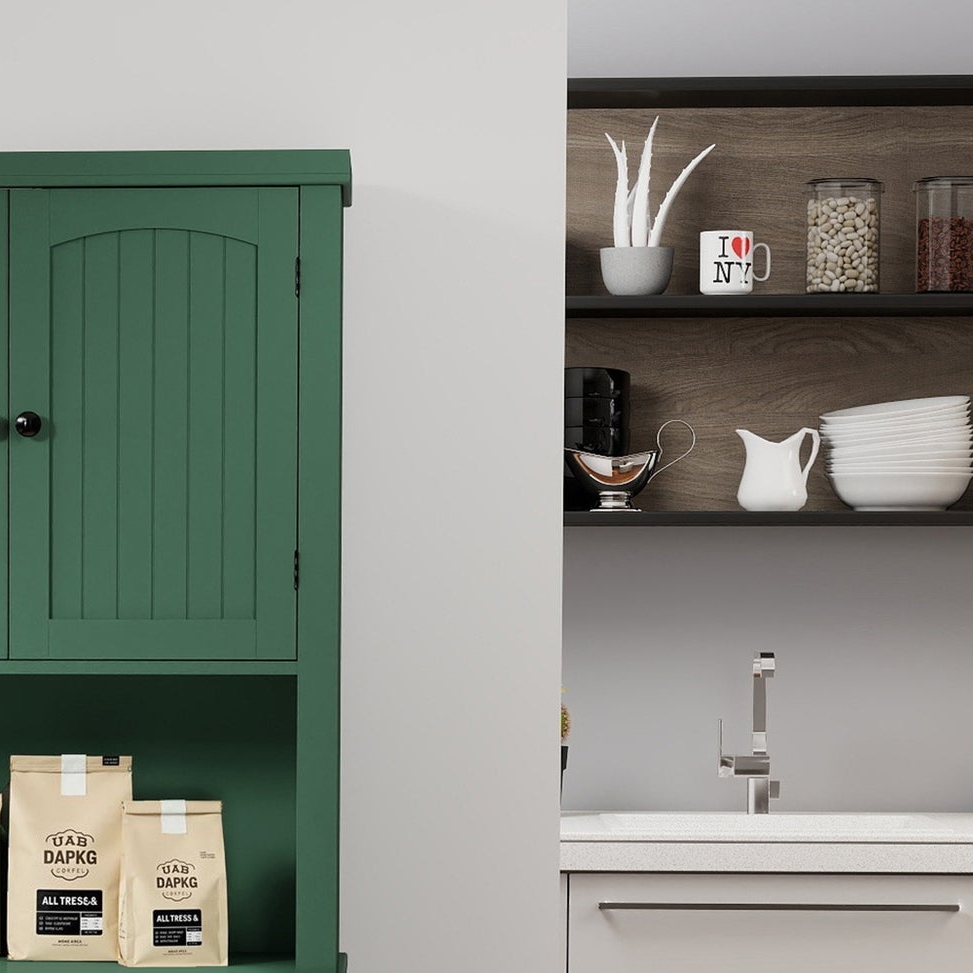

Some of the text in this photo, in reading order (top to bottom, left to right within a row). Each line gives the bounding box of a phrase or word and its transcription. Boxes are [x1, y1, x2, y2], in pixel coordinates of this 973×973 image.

[718, 236, 729, 258] I
[713, 261, 752, 284] NY
[52, 835, 88, 847] UAB
[43, 850, 98, 865] DAPKG
[161, 864, 190, 875] UAB
[156, 876, 198, 889] DAPKG
[42, 896, 59, 906] ALL
[156, 914, 169, 923] ALL
